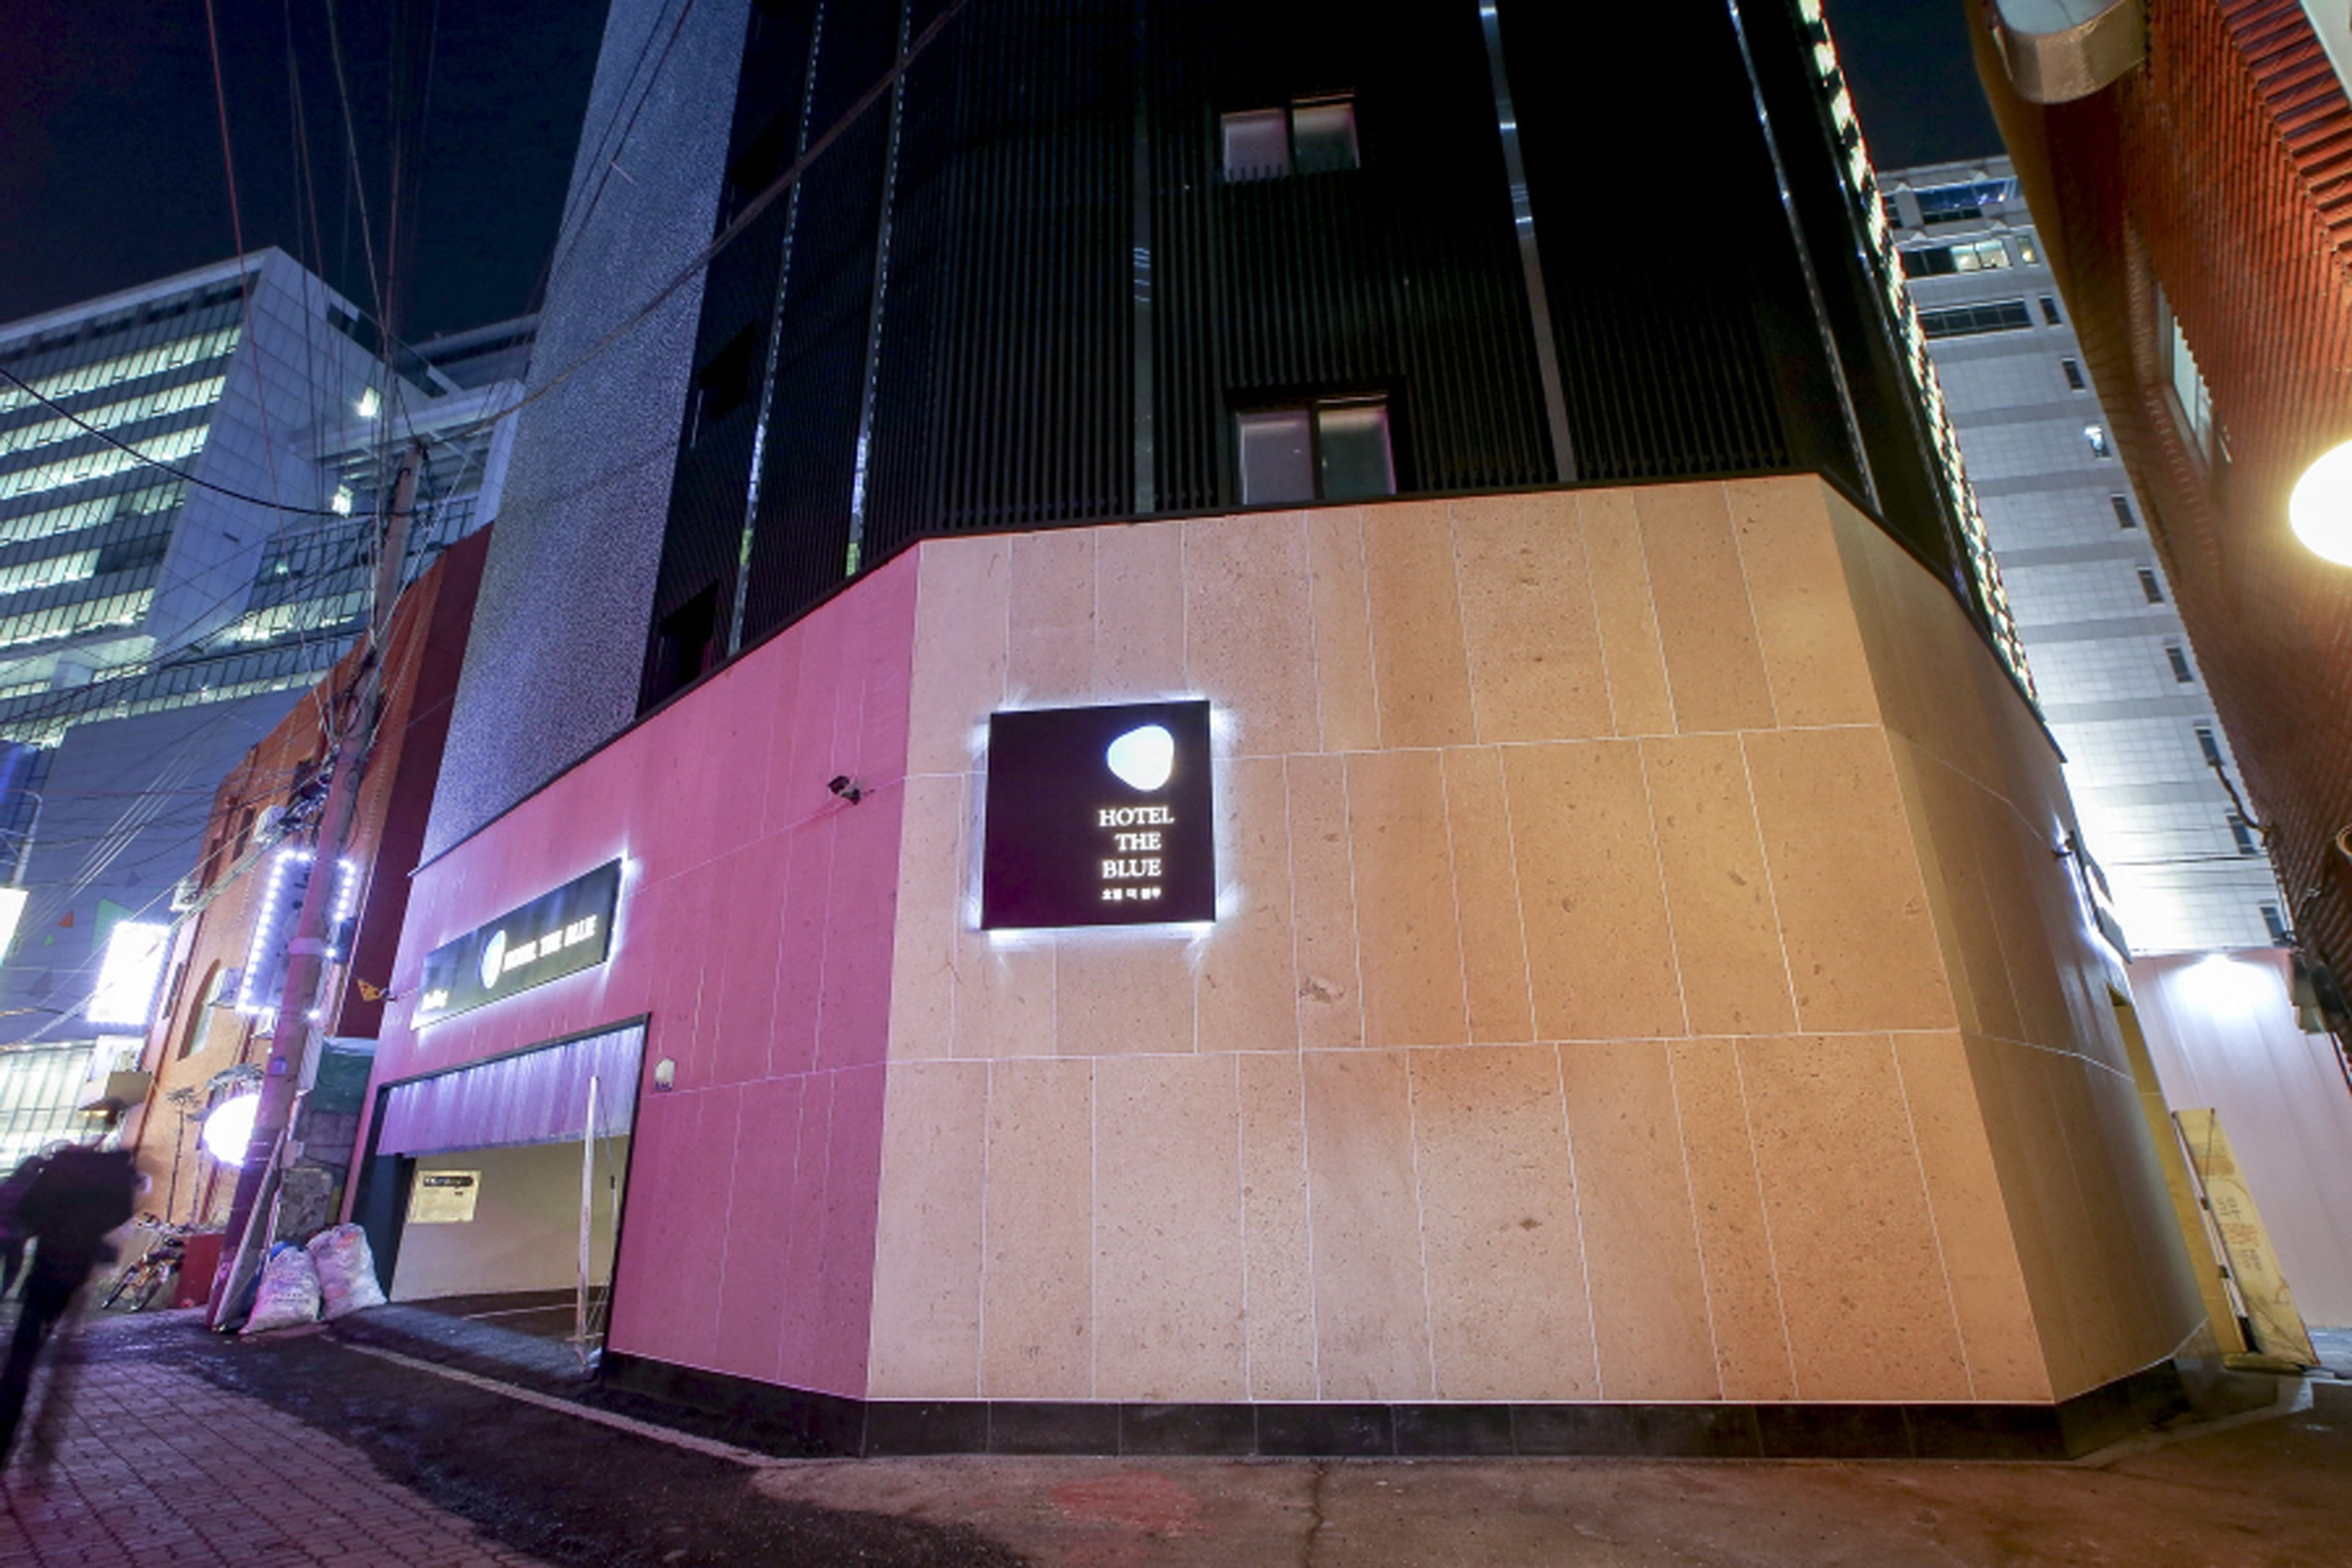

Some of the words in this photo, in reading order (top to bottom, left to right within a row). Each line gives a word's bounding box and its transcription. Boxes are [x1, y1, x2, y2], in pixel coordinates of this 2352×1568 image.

[1098, 805, 1175, 827] HOTEL
[1114, 832, 1162, 851] THE
[1102, 859, 1162, 879] BLUE
